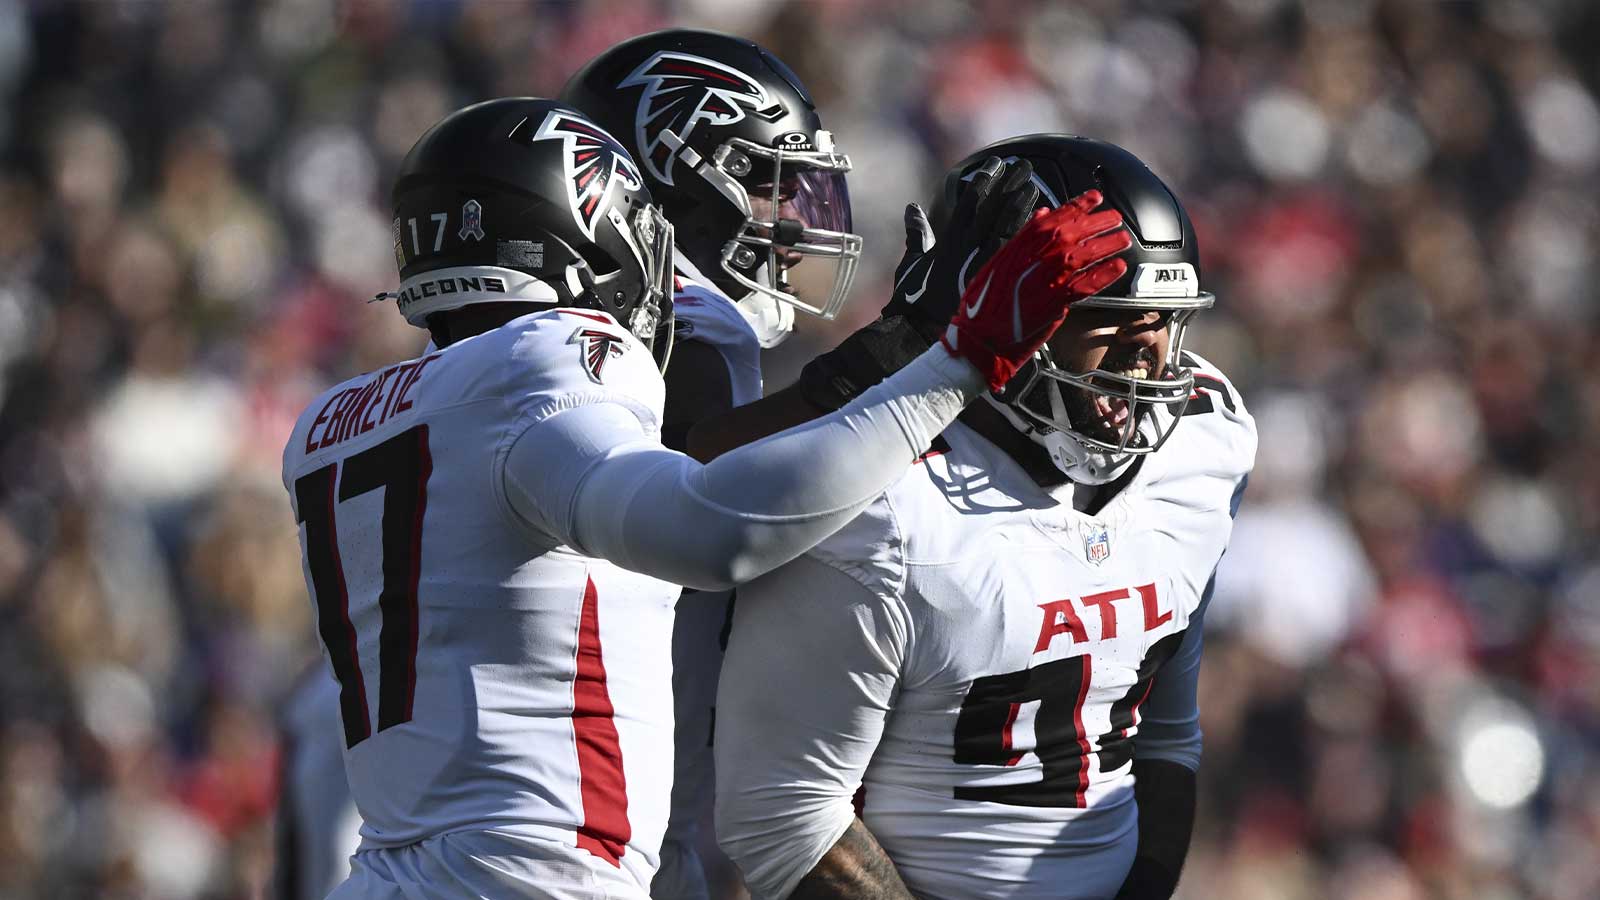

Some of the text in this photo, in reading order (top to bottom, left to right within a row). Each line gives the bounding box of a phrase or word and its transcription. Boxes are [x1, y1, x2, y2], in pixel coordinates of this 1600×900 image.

[408, 212, 448, 256] 17
[1154, 269, 1188, 283] ATL
[305, 354, 443, 455] EBIKETIE
[1090, 543, 1107, 559] NFL
[295, 423, 434, 750] 17
[1033, 582, 1173, 655] ATL
